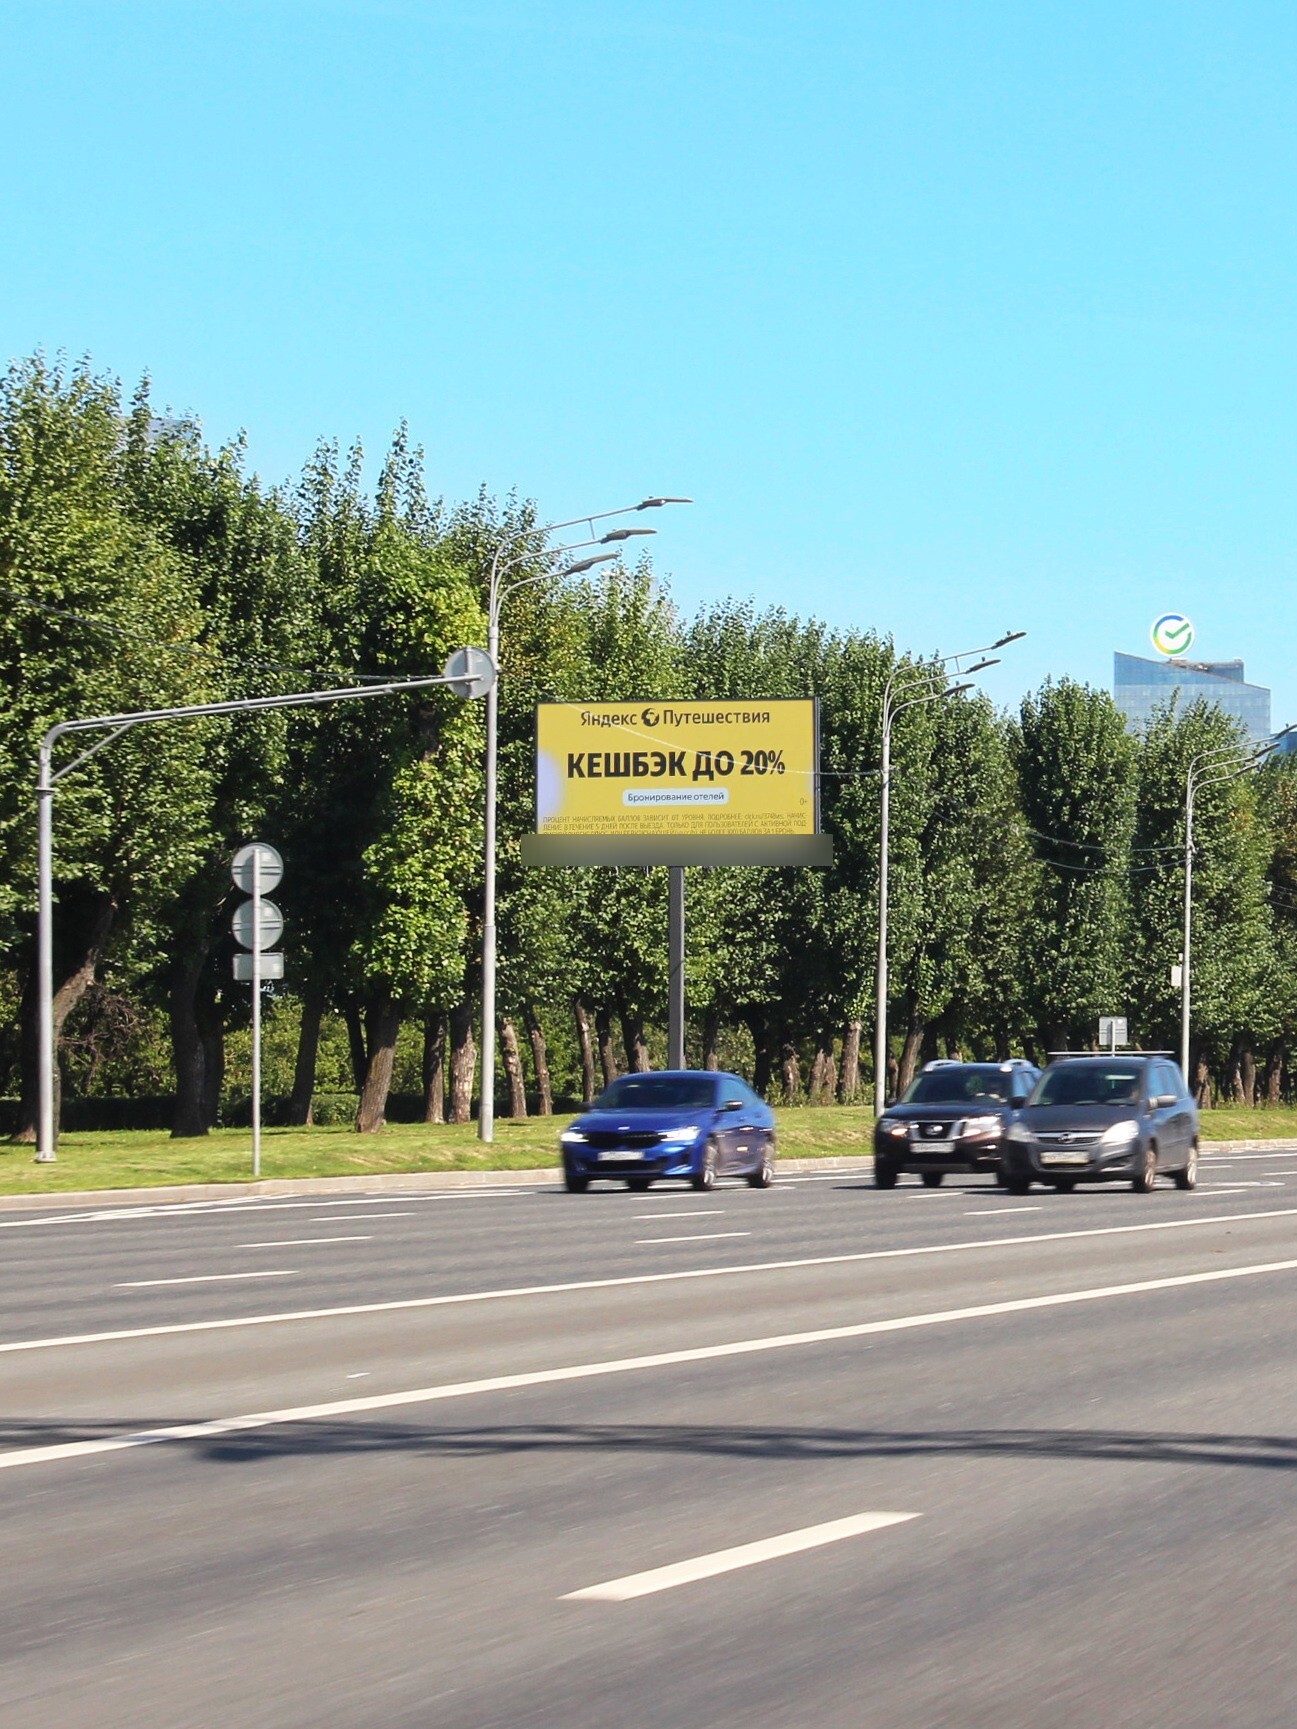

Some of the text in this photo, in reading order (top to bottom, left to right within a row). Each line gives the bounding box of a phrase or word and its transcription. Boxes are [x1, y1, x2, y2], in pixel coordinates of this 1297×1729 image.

[580, 709, 770, 728] Яндекс Путешествия
[567, 749, 786, 781] КЕШБЭК ДО 20%
[627, 792, 725, 803] Бронирование отелей
